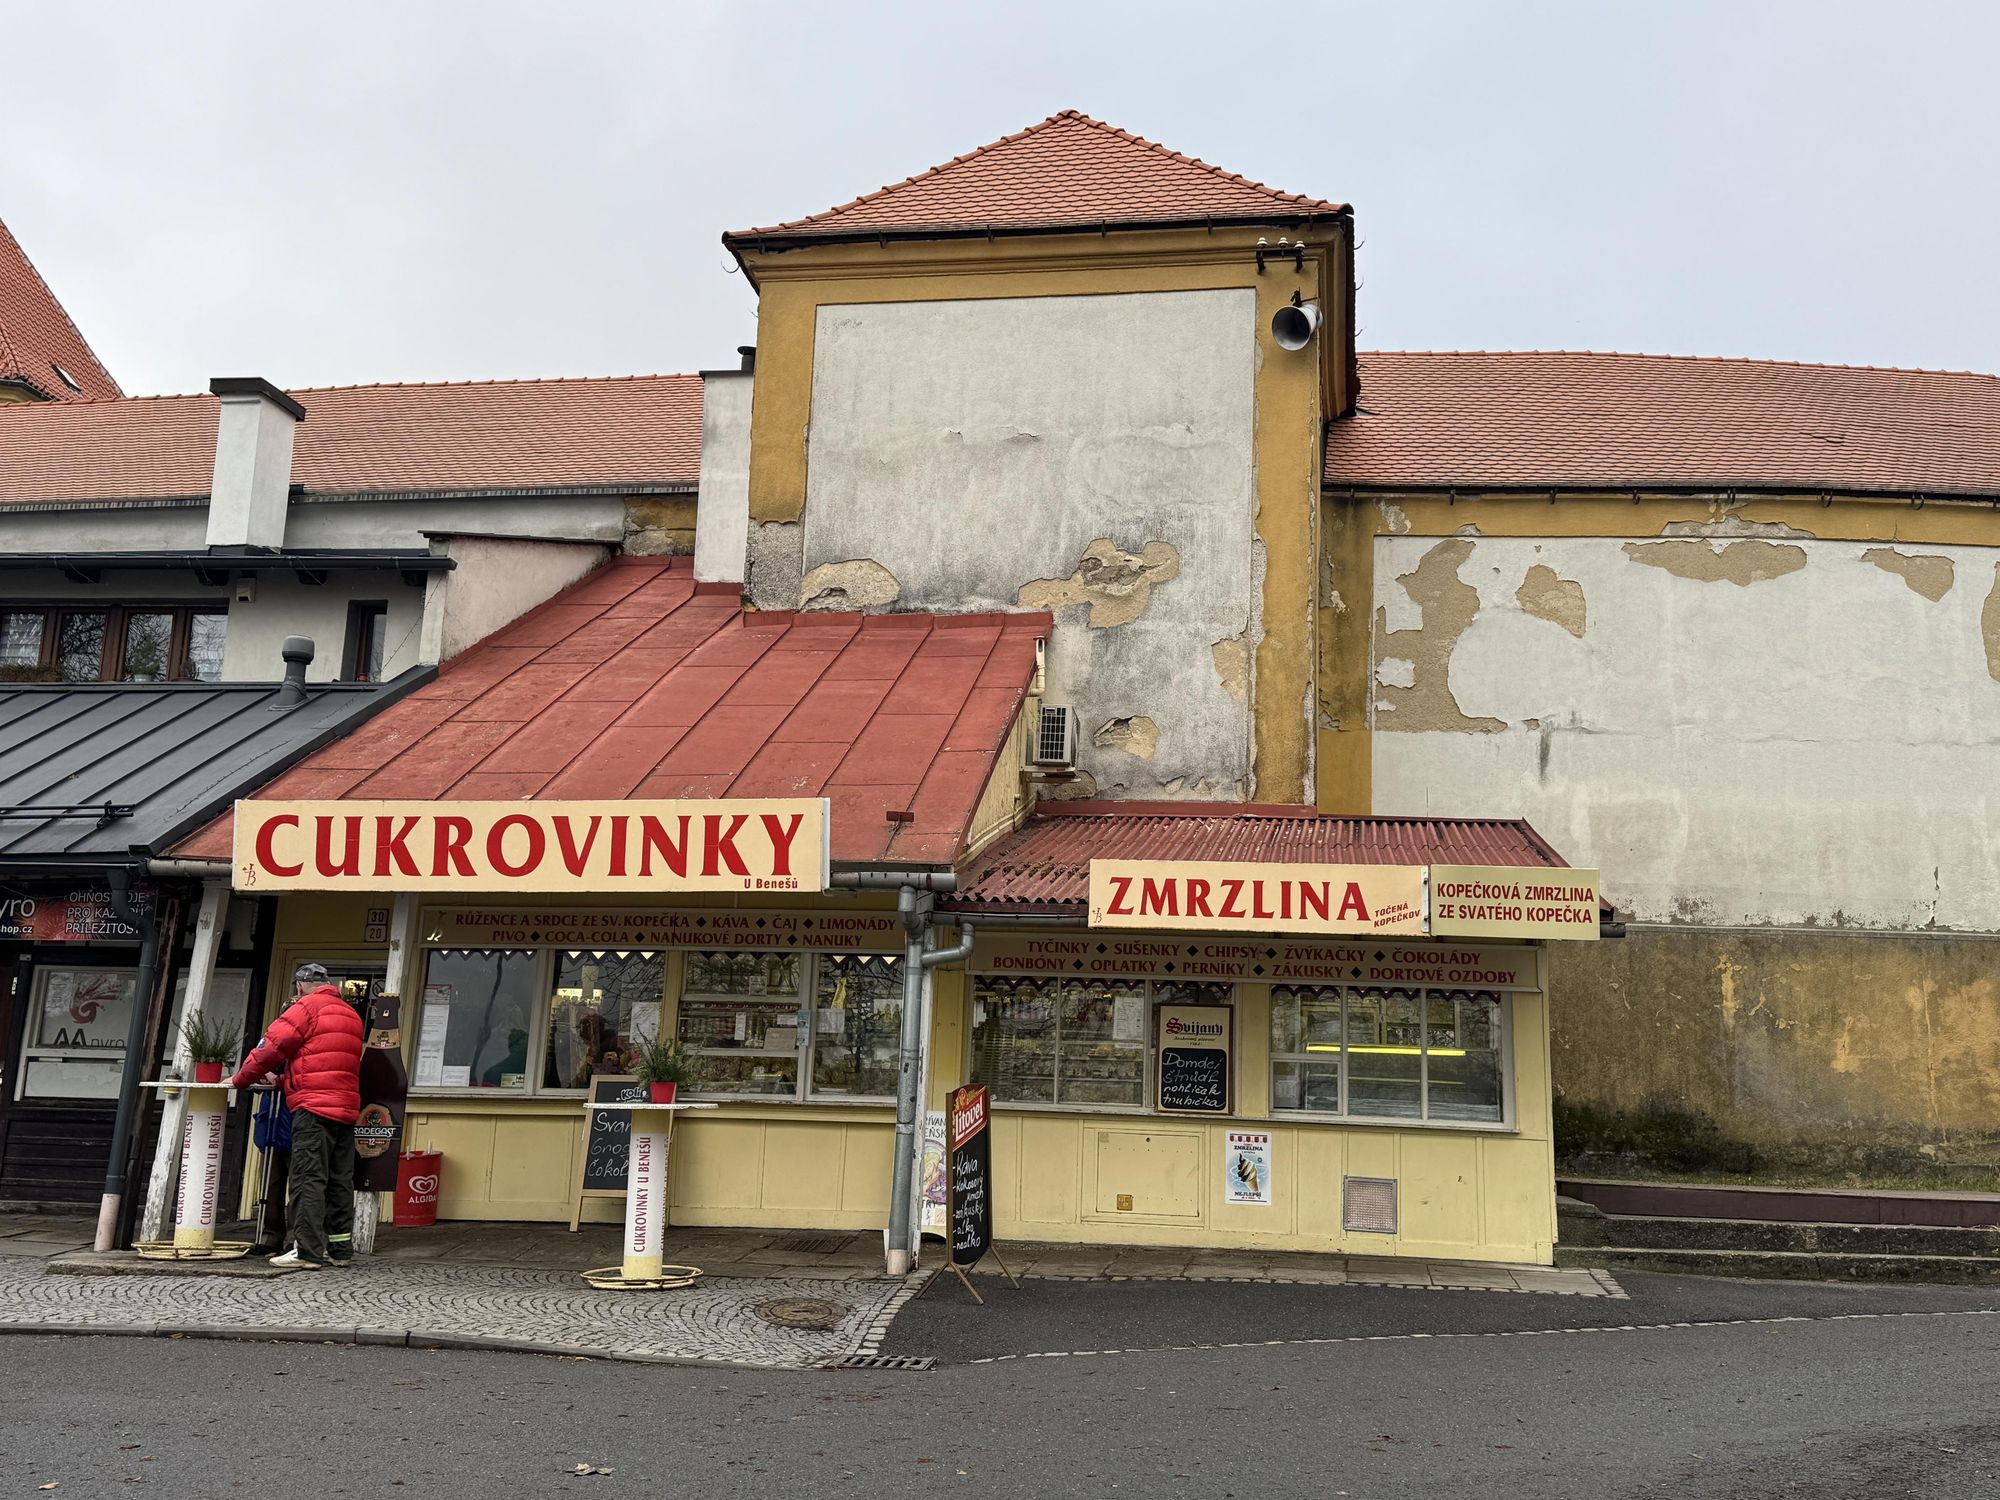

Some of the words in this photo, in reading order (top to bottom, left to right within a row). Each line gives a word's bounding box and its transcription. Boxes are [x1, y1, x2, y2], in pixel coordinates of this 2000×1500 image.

[255, 814, 804, 878] CUKROVINKY
[744, 879, 751, 889] U
[756, 877, 798, 889] Benešů
[1437, 881, 1520, 901] KOPEČKOVÁ
[1525, 884, 1594, 903] ZMRZLINA
[1106, 876, 1371, 922] ZMRZLINA
[1375, 900, 1409, 917] TOČENÁ
[67, 907, 91, 919] PRO
[371, 911, 385, 922] 30
[456, 910, 517, 926] RŮŽENCE
[521, 915, 530, 926] A
[534, 914, 578, 927] SRDCE
[583, 915, 598, 927] ZE
[601, 915, 622, 928] SV.
[624, 912, 690, 928] KOPEČKA
[712, 913, 749, 929] KÁVA
[773, 914, 798, 931] ČAJ
[819, 916, 896, 931] LIMONÁDY
[1374, 909, 1421, 928] KOPEČKOV
[1438, 904, 1455, 919] ZE
[1459, 903, 1522, 922] SVATÉHO
[1526, 905, 1593, 924] KOPEČKA
[370, 928, 381, 939] 20
[492, 930, 525, 942] PIVO
[545, 931, 629, 943] COCA-COLA
[650, 931, 730, 945] NANUKOVÉ
[734, 933, 782, 945] DORTY
[803, 934, 863, 946] NANUKY
[1027, 938, 1089, 954] TYČINKY
[1114, 940, 1181, 956] SUŠENKY
[1204, 945, 1258, 959] CHIPSY
[1284, 945, 1366, 962] ŽVÝKAČKY
[1392, 948, 1481, 965] ČOKOLÁDY
[993, 955, 1066, 970] BONBÓNY
[1090, 959, 1157, 973] OPLATKY
[1182, 961, 1246, 975] PERNÍKY
[1272, 963, 1343, 979] ZÁKUSKY
[1370, 967, 1443, 982] DORTOVÉ
[1448, 970, 1516, 984] OZDOBY
[1166, 1017, 1222, 1036] Svijany
[955, 1094, 984, 1142] Litovel
[207, 1115, 221, 1149] BENEŠŮ
[636, 1136, 651, 1173] BENEŠŮ
[175, 1163, 189, 1225] CUKROVINKY
[200, 1163, 217, 1225] CUKROVINKY
[408, 1195, 437, 1204] ALGIDA
[633, 1187, 649, 1253] CUKROVINKY
